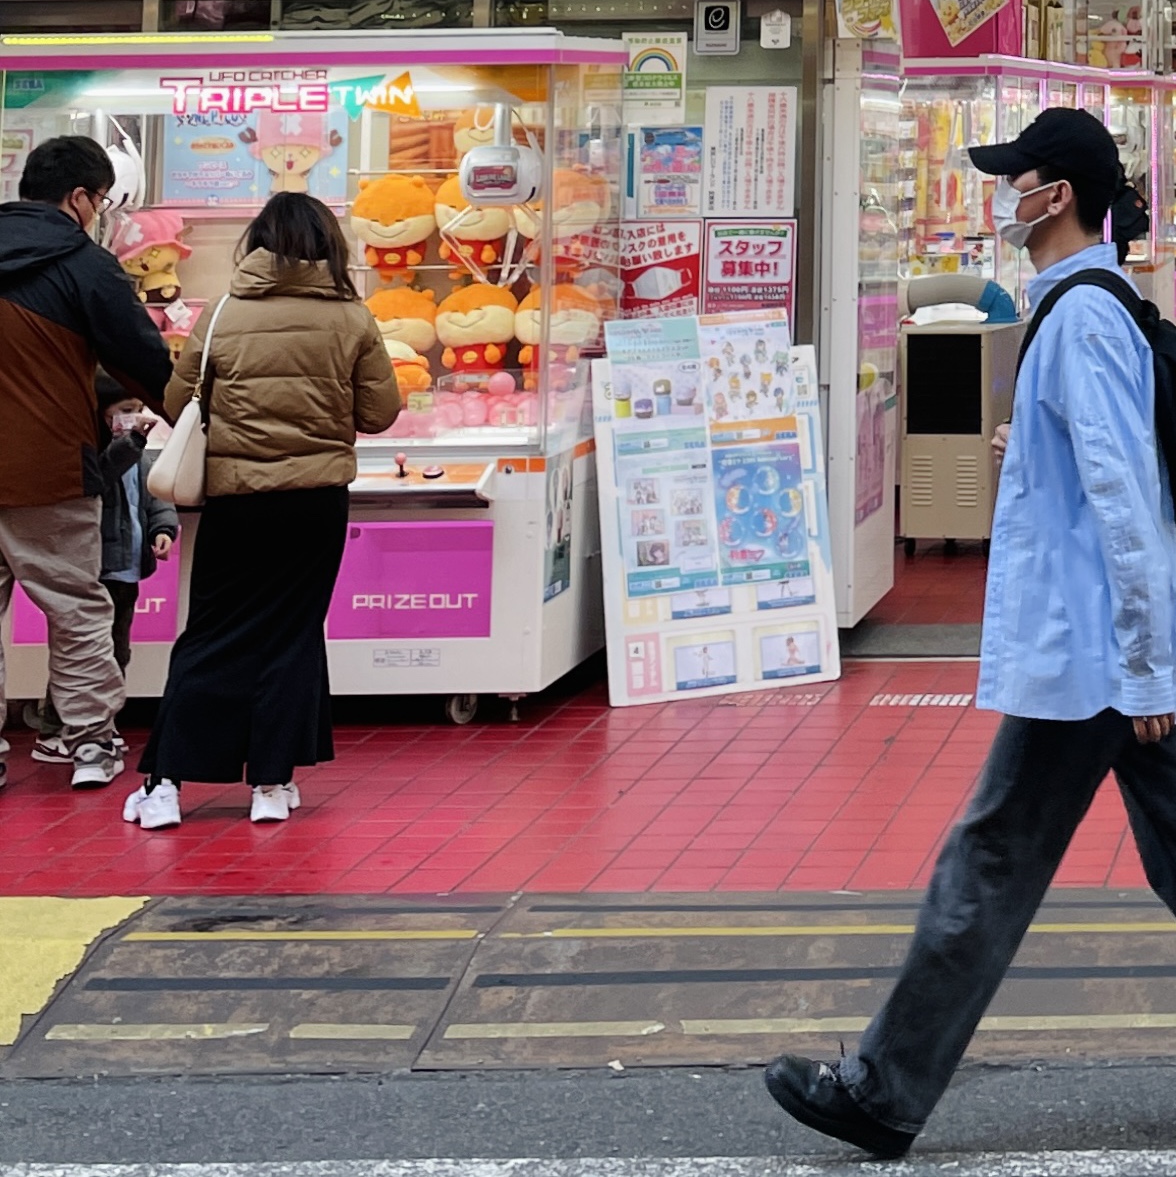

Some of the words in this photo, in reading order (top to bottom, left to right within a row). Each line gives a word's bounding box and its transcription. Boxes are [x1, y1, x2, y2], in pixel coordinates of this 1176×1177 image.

[209, 71, 246, 82] UFO
[248, 69, 328, 81] CATCHER
[160, 77, 329, 114] TRIPLE
[331, 84, 414, 105] TWIN
[718, 240, 783, 256] スタッフ
[721, 260, 779, 277] 募集中!
[352, 593, 479, 610] PRIZEOUT
